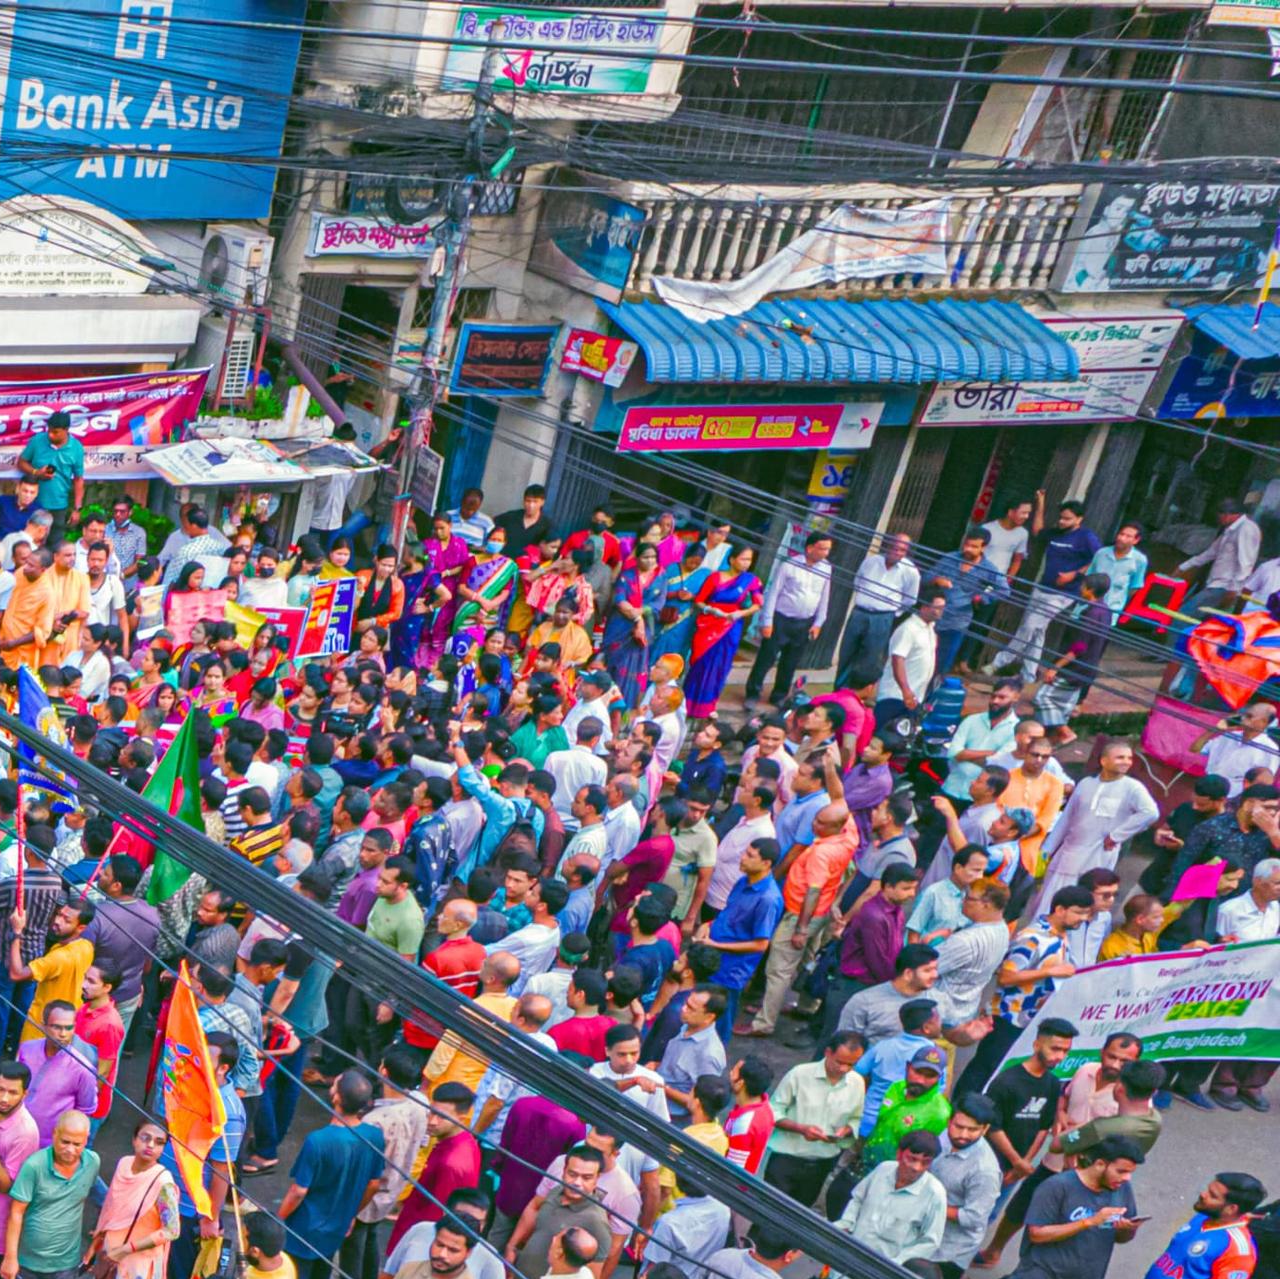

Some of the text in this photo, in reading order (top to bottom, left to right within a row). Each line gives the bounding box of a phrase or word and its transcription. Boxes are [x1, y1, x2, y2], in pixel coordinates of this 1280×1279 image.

[16, 79, 244, 130] Bank Asia
[75, 144, 172, 178] ATM
[708, 421, 731, 436] ৫০
[1081, 1004, 1104, 1020] WE
[1115, 999, 1163, 1020] WANT
[1167, 1001, 1243, 1020] PEACE
[1162, 1032, 1247, 1050] Bangladesh
